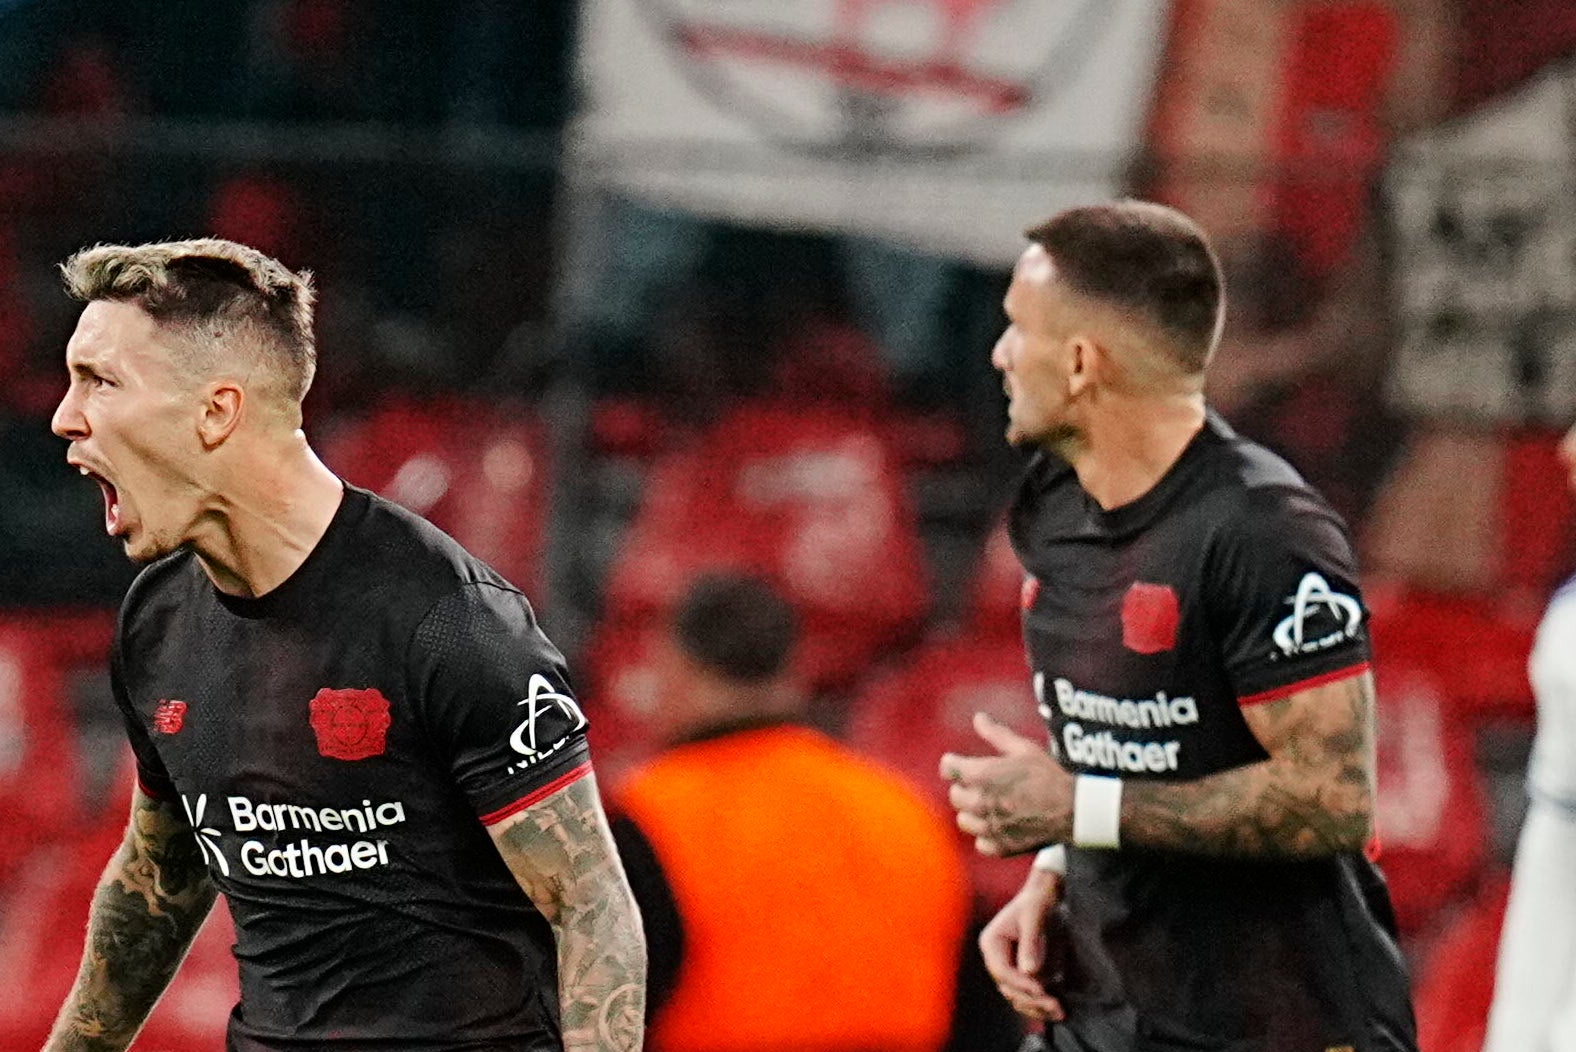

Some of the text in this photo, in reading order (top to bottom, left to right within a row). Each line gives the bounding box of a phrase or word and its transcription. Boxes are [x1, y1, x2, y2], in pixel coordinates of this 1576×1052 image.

[1053, 678, 1199, 729] Barmenia
[1063, 722, 1181, 773] Gothaer
[227, 796, 406, 833] Barmenia
[240, 839, 390, 878] Gothaer
